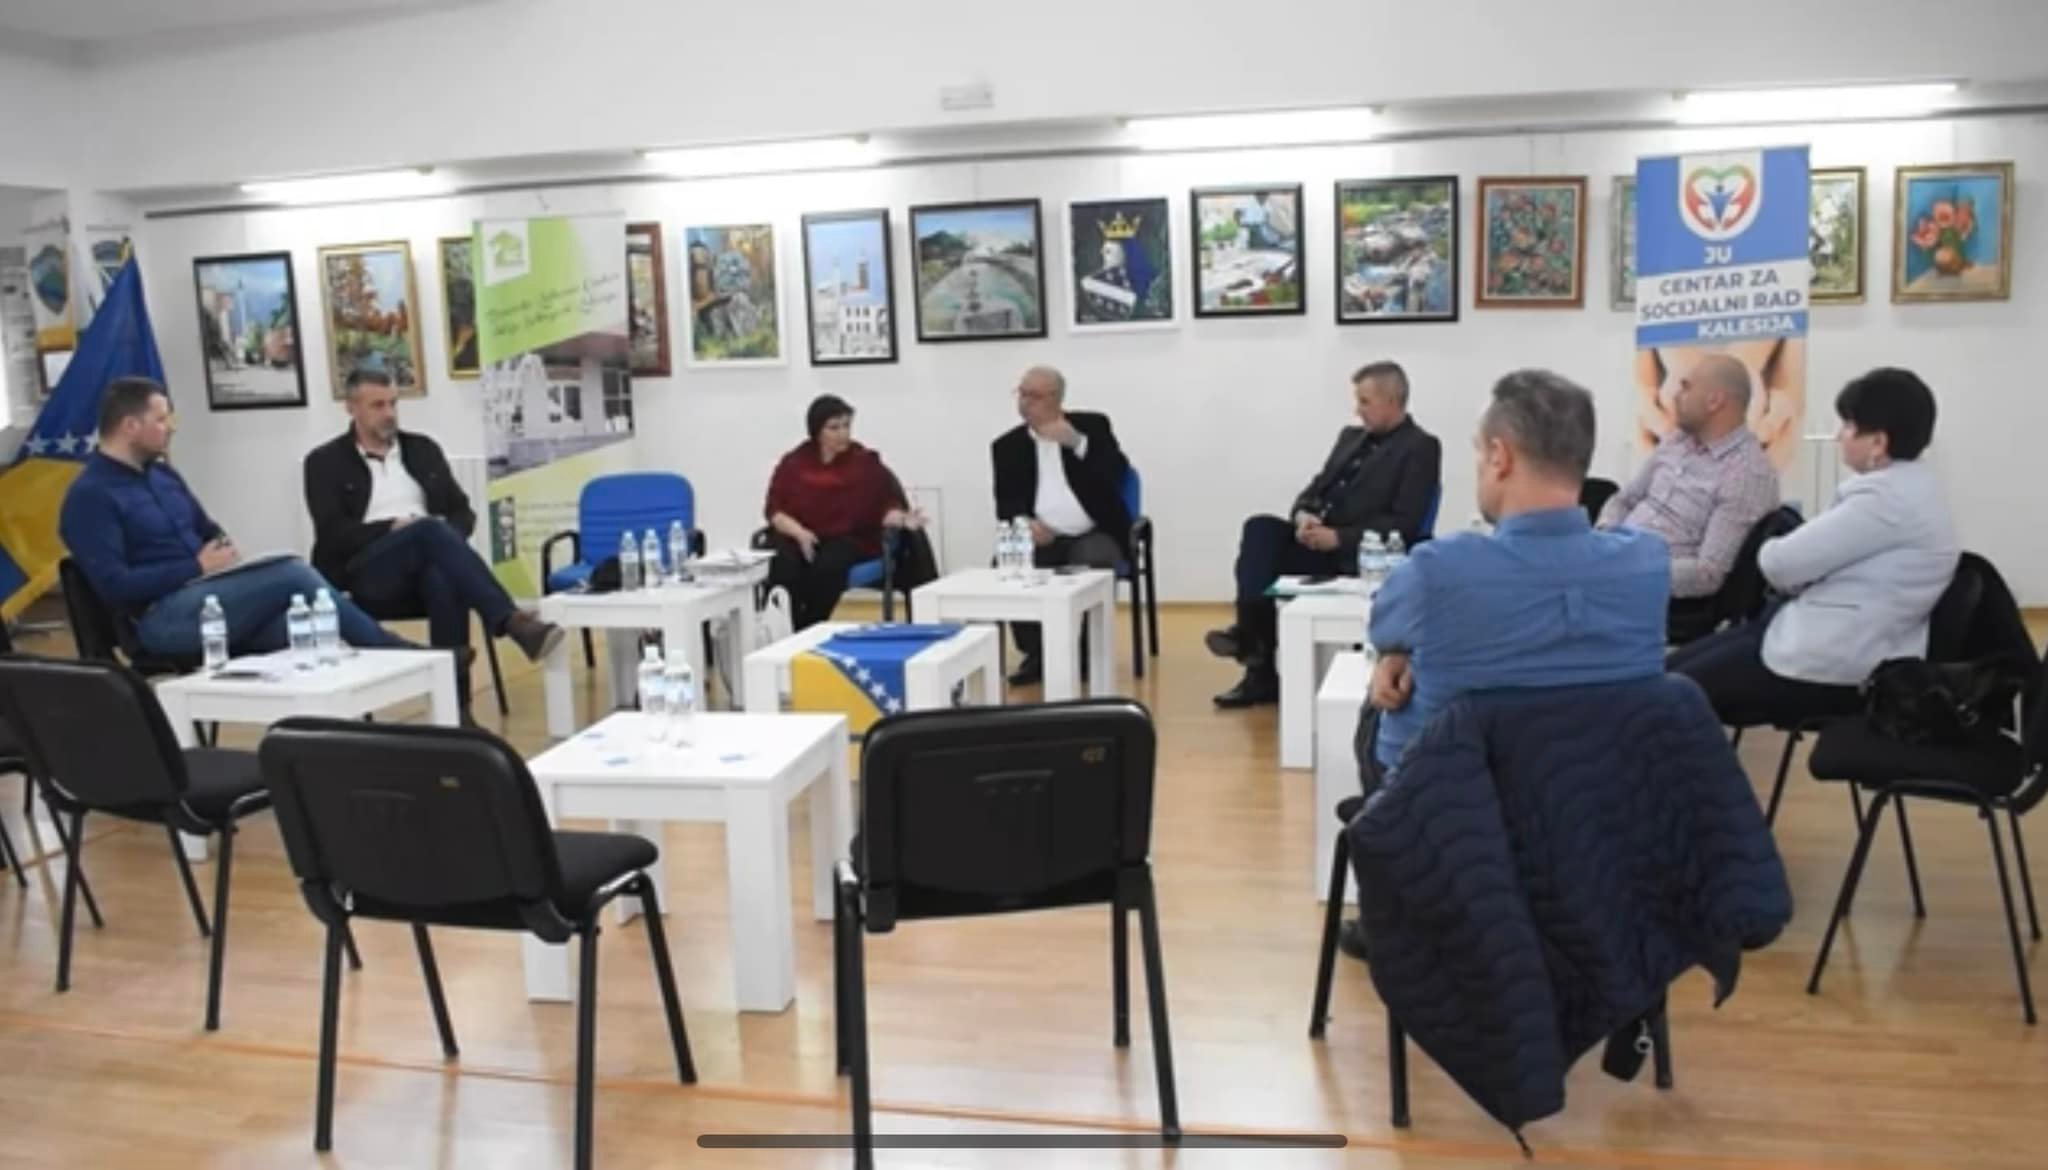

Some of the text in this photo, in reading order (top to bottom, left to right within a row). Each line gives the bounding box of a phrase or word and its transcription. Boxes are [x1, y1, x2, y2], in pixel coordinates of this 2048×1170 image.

[1704, 246, 1732, 264] JU
[1660, 269, 1779, 296] CENTAR ZA
[1641, 290, 1801, 320] SOCIJALNI RAD
